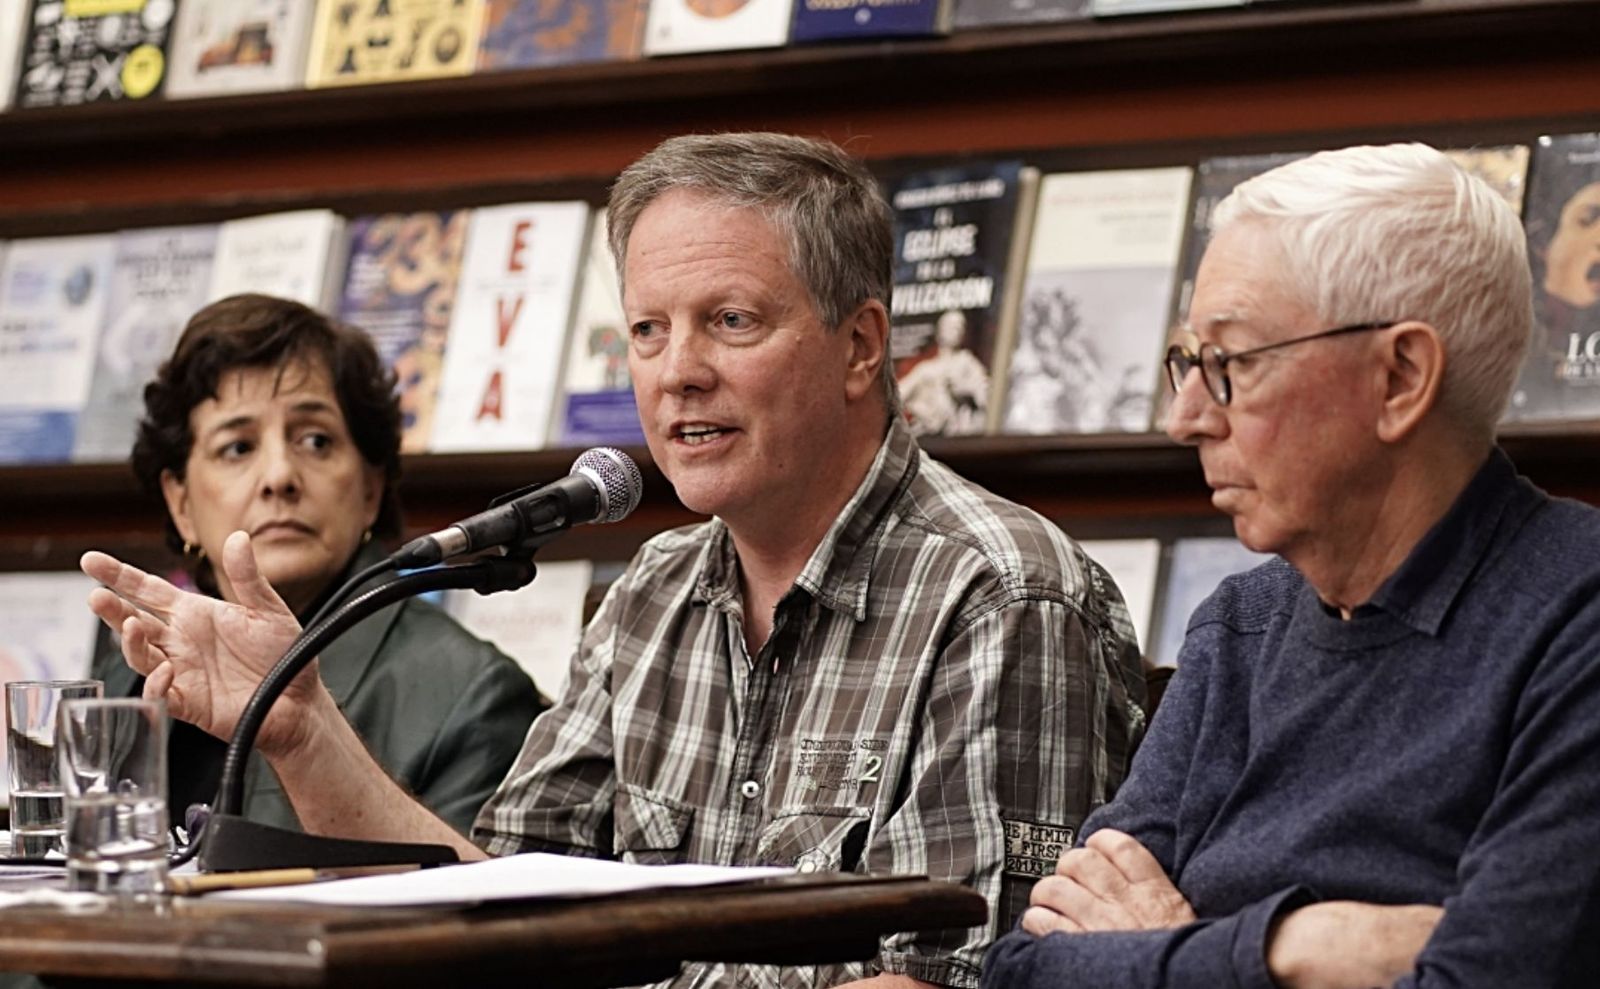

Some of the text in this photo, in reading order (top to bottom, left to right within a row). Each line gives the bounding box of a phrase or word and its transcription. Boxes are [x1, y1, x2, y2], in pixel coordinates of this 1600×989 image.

[474, 219, 537, 423] EVA
[858, 755, 882, 783] 2
[1029, 826, 1071, 844] LIMIT
[1021, 841, 1063, 860] FIRST
